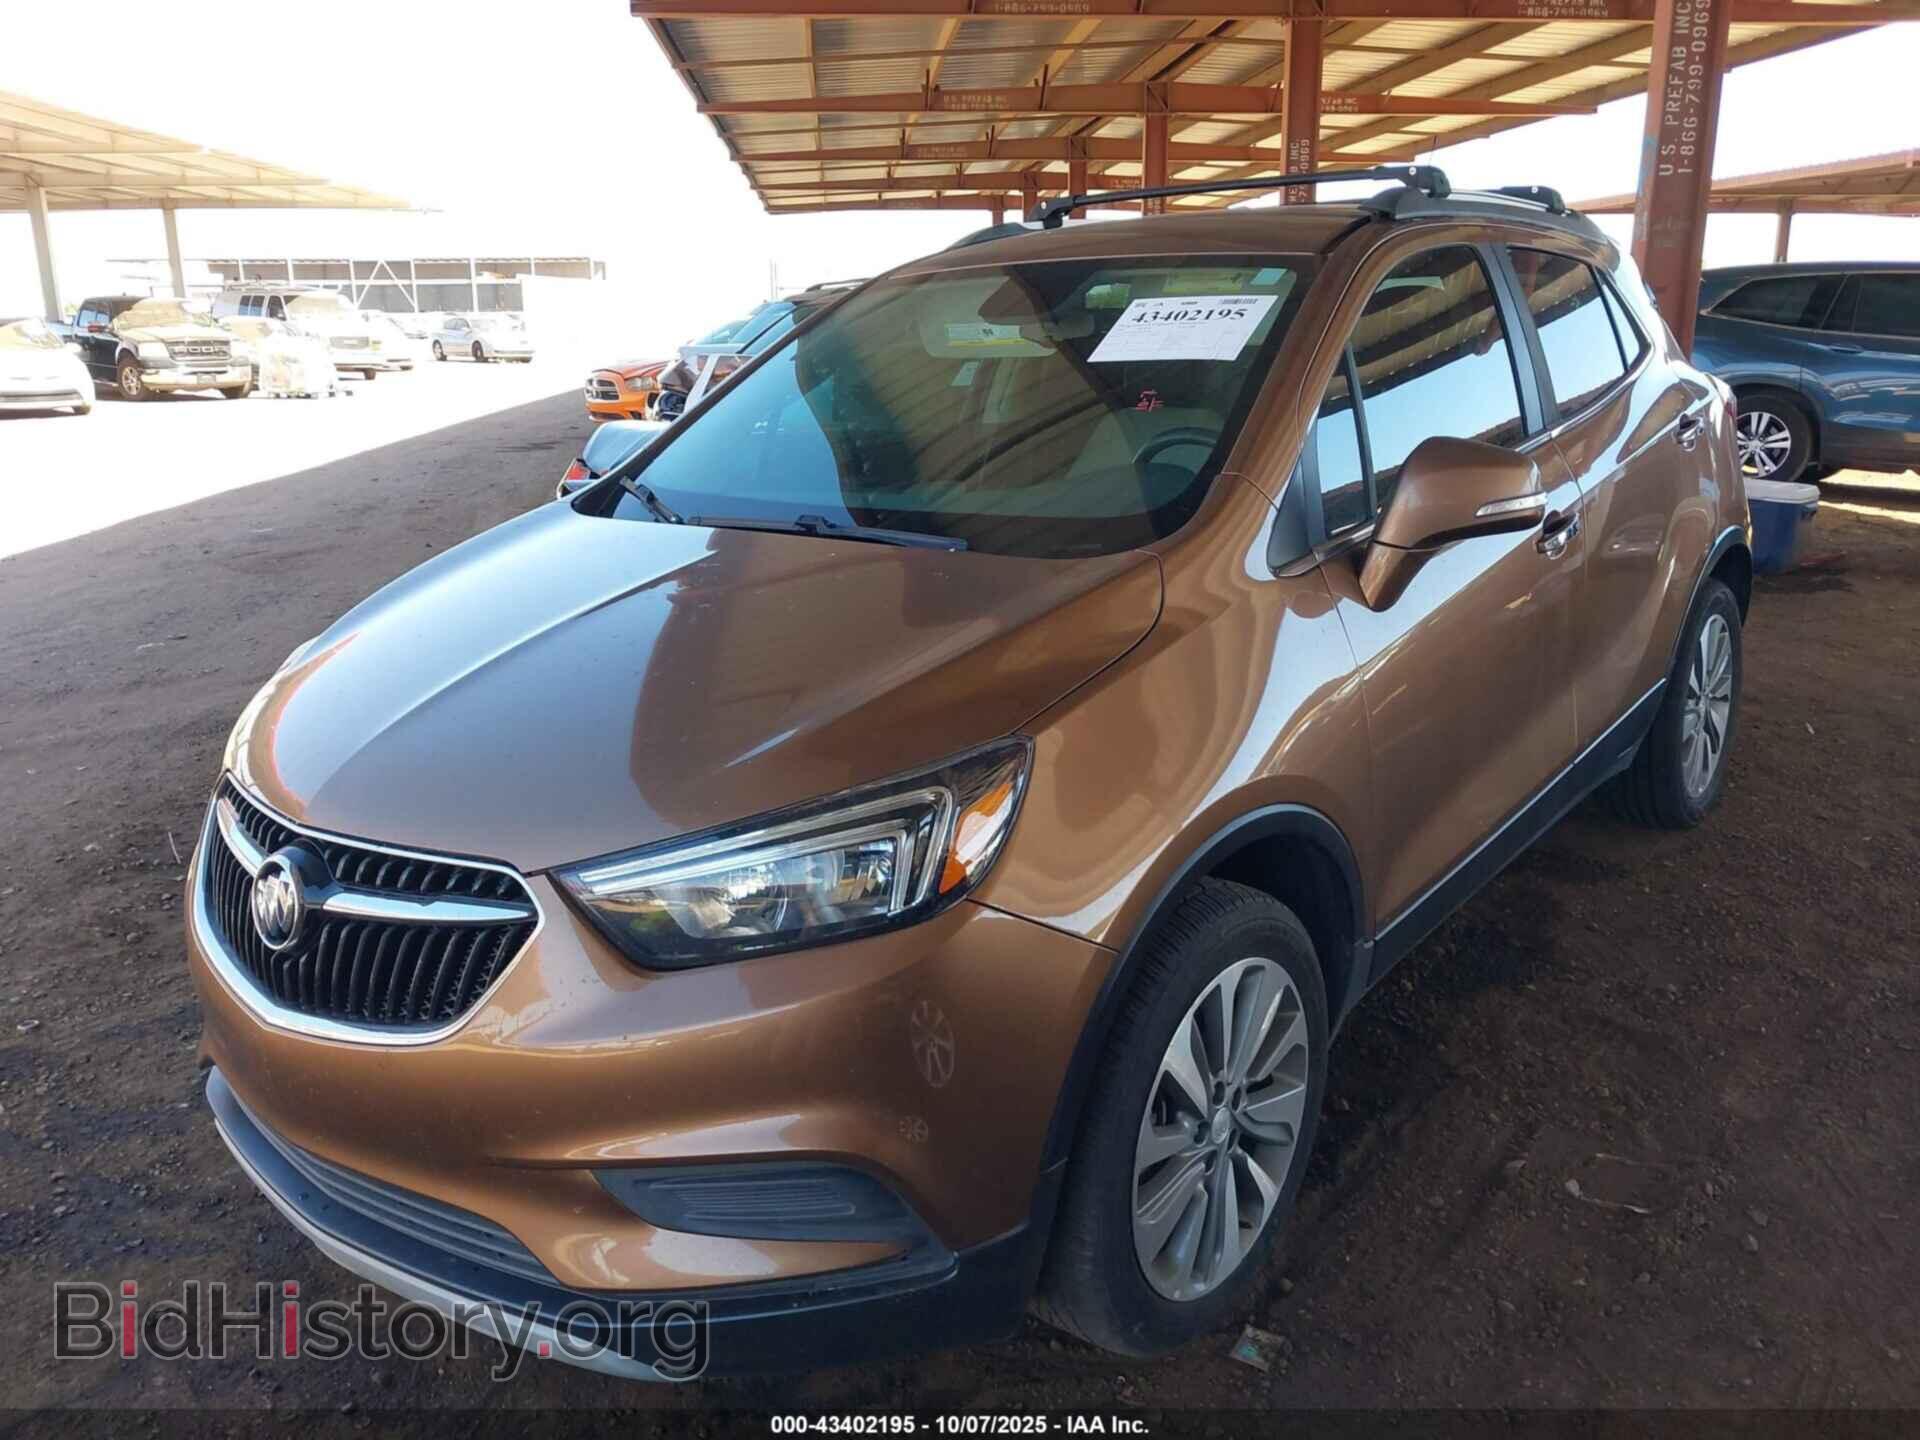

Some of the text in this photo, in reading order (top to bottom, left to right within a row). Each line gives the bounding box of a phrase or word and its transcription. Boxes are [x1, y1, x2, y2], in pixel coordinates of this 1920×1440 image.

[1664, 46, 1688, 125] PREFAB
[1677, 0, 1712, 174] 1-866-799-0969
[1132, 308, 1249, 323] 43402195
